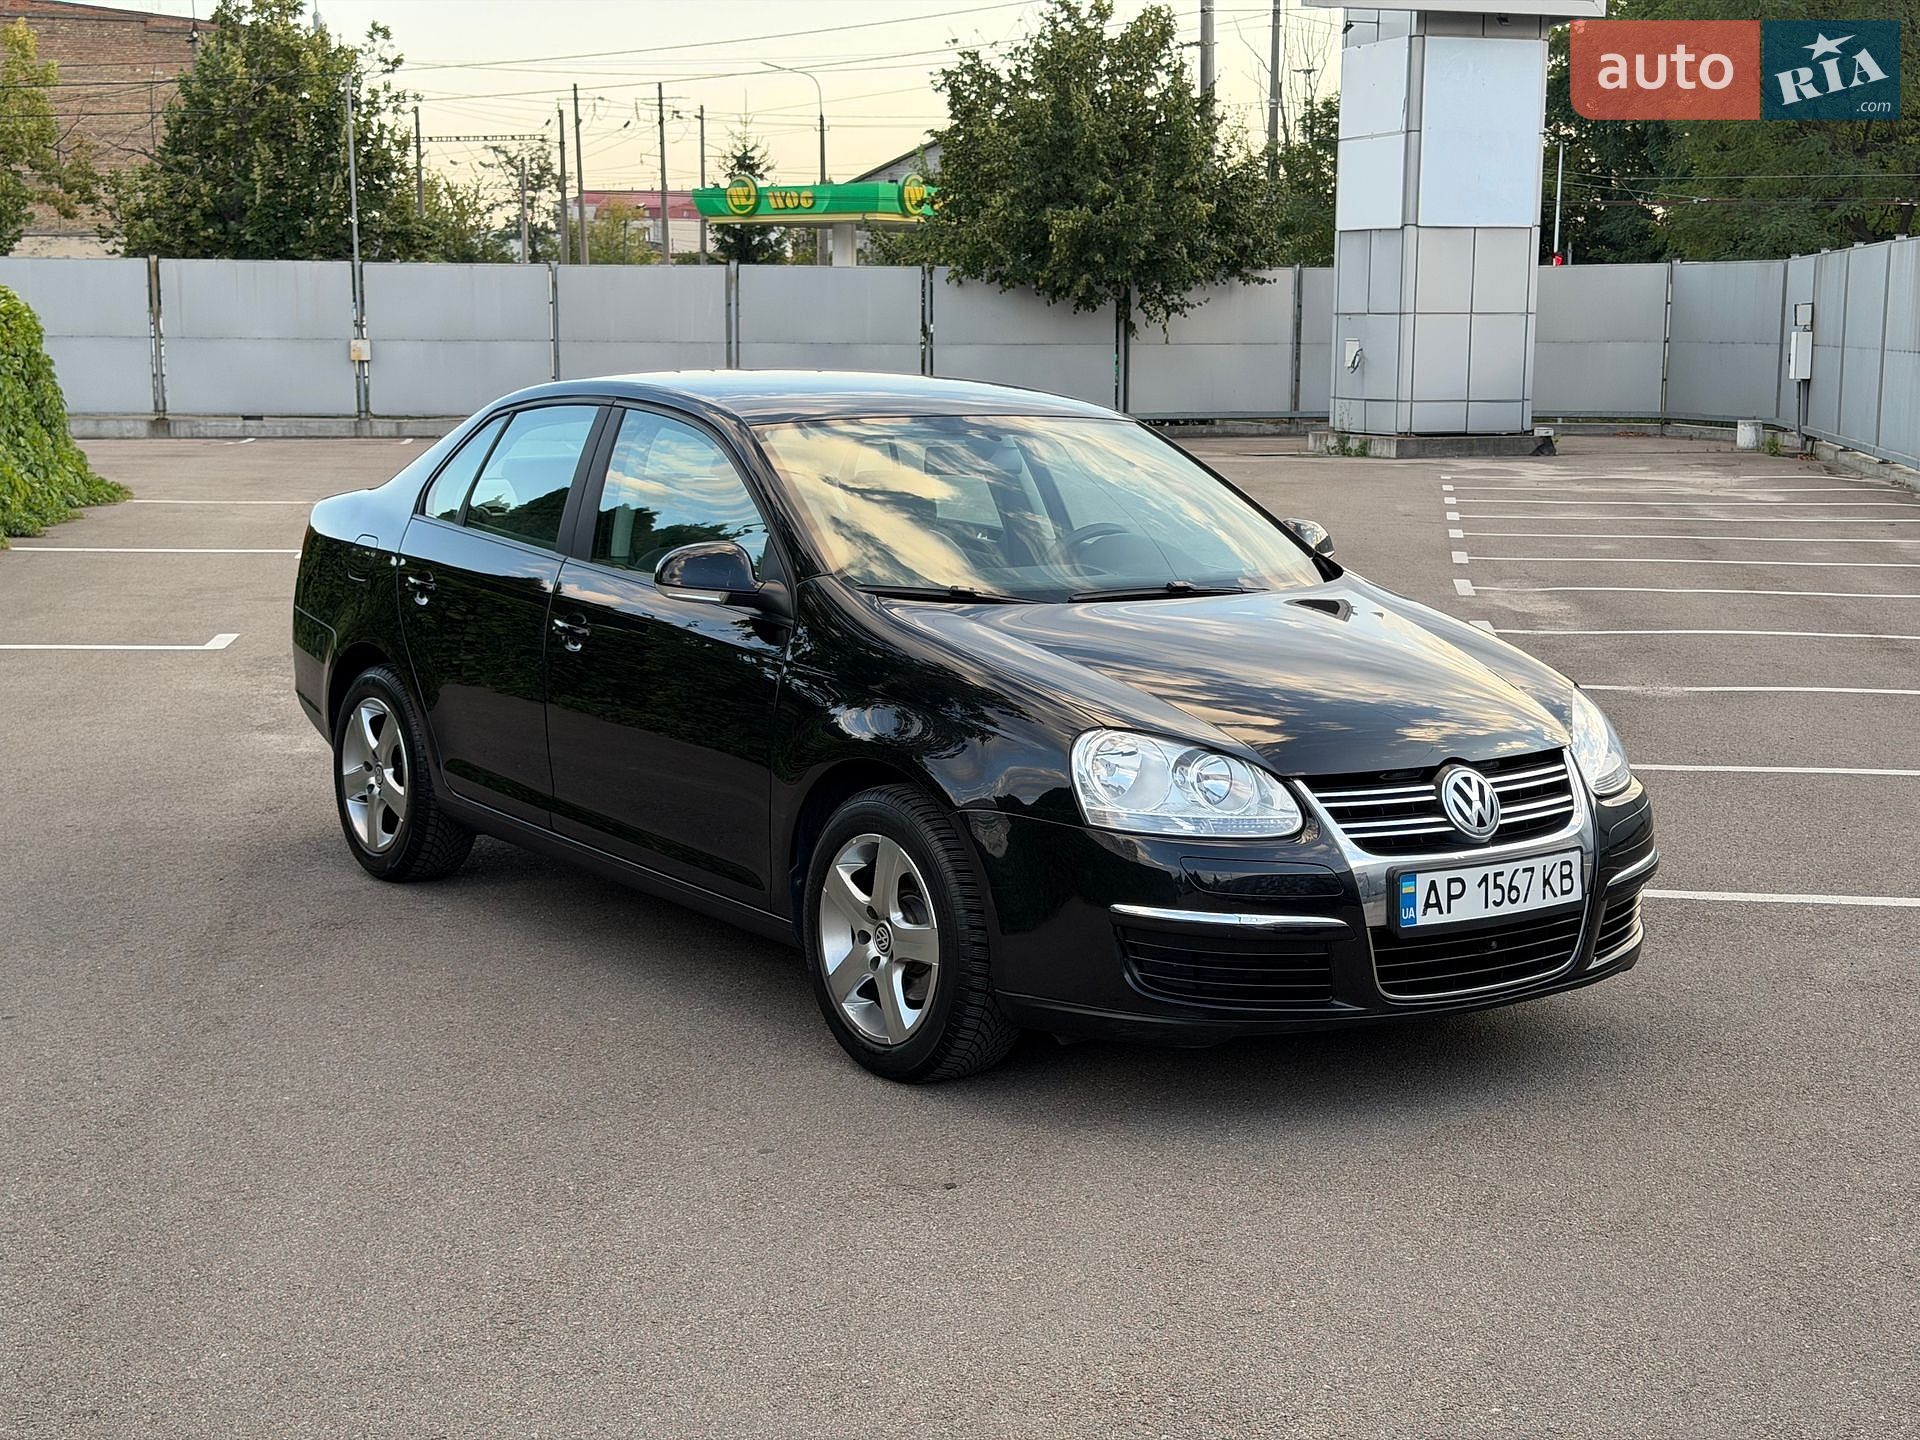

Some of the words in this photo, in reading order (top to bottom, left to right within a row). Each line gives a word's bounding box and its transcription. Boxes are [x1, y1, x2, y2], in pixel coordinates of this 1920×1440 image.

[1421, 876, 1467, 917] AP
[1477, 866, 1535, 909] 1567
[1542, 860, 1574, 900] KB
[1401, 906, 1416, 920] UA
